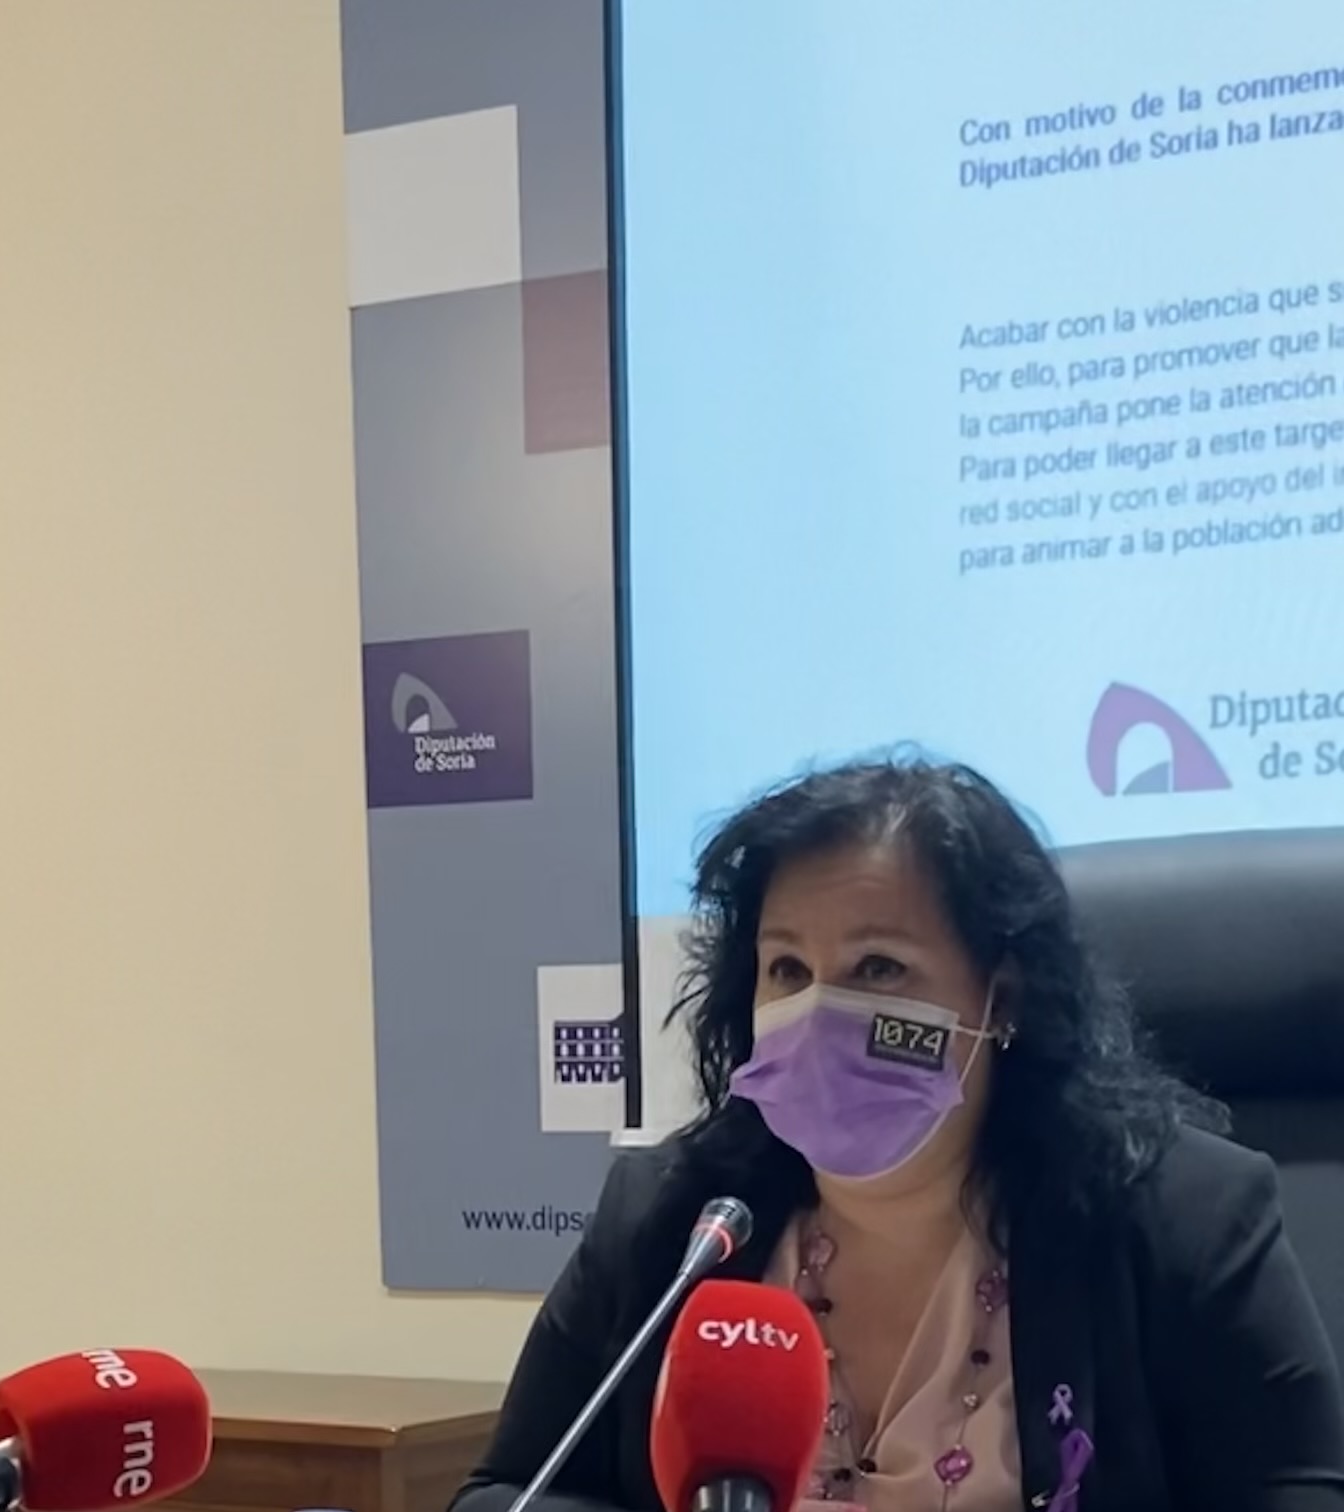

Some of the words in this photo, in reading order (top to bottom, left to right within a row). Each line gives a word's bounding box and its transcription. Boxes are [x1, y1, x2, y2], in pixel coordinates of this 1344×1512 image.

[958, 118, 1012, 147] Con
[1024, 101, 1118, 139] motivo
[1130, 91, 1166, 122] de
[1177, 84, 1203, 114] la
[958, 143, 1102, 191] Diputación
[1107, 136, 1143, 167] de
[1148, 123, 1220, 160] Soria
[1226, 118, 1262, 148] ha
[957, 319, 1050, 350] Acabar
[1056, 313, 1107, 341] con
[1112, 306, 1137, 333] la
[1143, 288, 1261, 329] violencia
[1267, 283, 1321, 316] que
[958, 367, 1003, 394] Por
[1009, 361, 1062, 390] ello,
[1066, 355, 1127, 390] para
[1132, 336, 1262, 381] promover
[1267, 329, 1321, 362] que
[958, 413, 982, 440] la
[987, 398, 1110, 437] campaña
[1115, 393, 1183, 429] pone
[1188, 386, 1212, 413] la
[1218, 370, 1337, 411] atención
[958, 454, 1017, 483] Para
[1023, 445, 1099, 482] poder
[1105, 439, 1179, 472] llegar
[1184, 435, 1202, 460] a
[1208, 427, 1267, 457] este
[414, 732, 496, 758] Diputación
[414, 753, 434, 773] de
[435, 752, 476, 771] Soria
[1258, 742, 1303, 781] de
[873, 1016, 945, 1056] 1074
[697, 1317, 800, 1352] cyltv
[113, 1419, 154, 1498] rne
